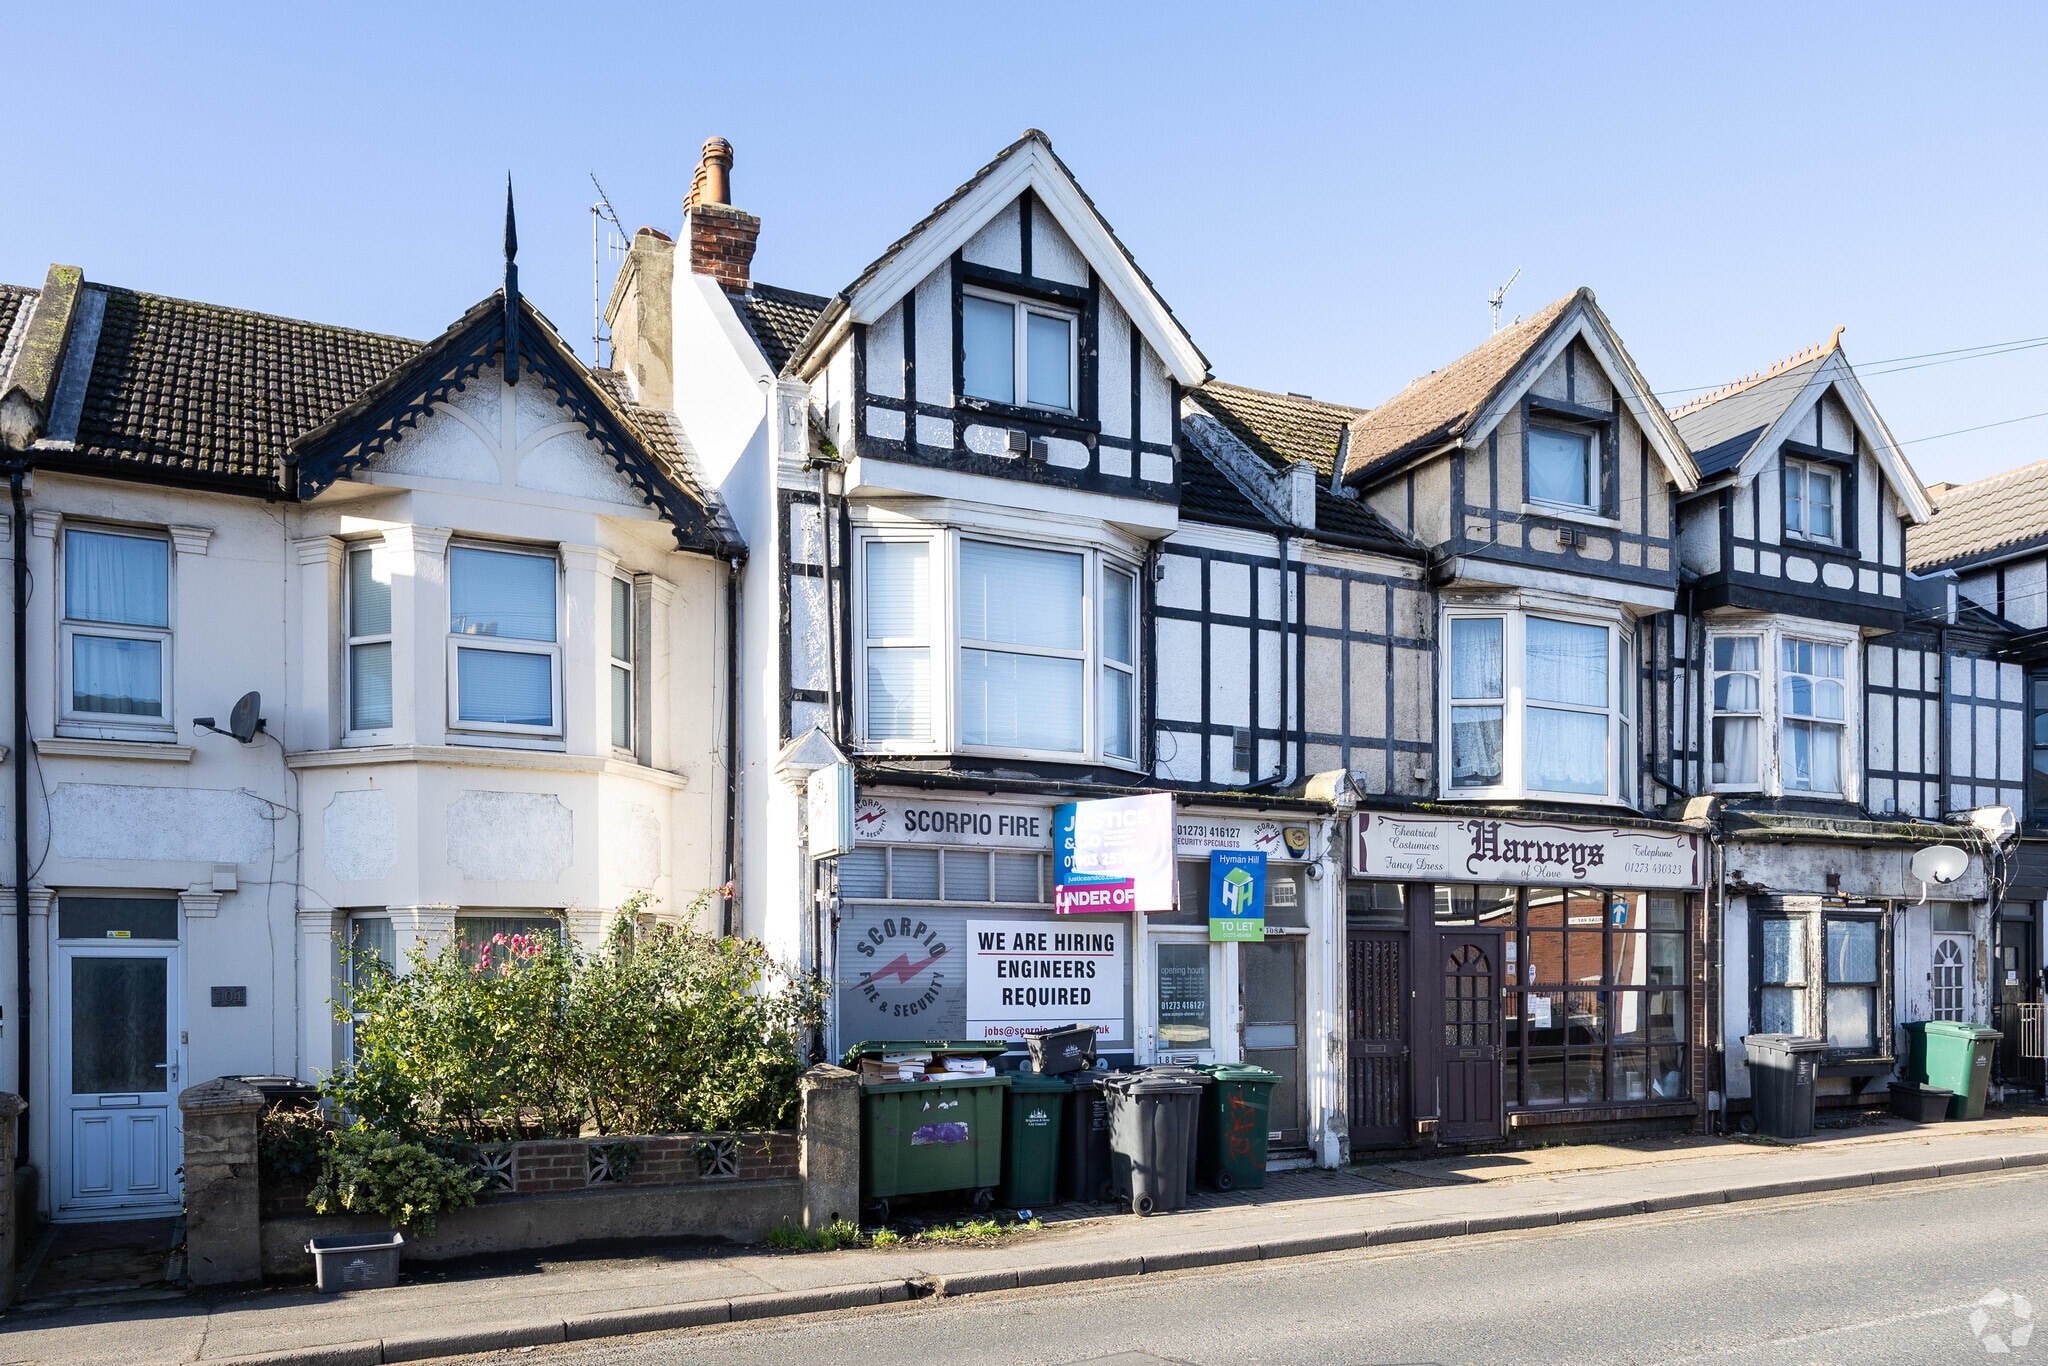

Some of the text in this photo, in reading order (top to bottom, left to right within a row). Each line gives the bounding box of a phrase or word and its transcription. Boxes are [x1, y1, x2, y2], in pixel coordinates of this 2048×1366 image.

[904, 809, 992, 836] SCORPIO
[998, 814, 1040, 838] FIRE
[1254, 822, 1280, 836] SCORPIO
[1391, 823, 1438, 838] Theatrical
[1210, 827, 1240, 838] 416127
[1177, 838, 1240, 848] ECURITY SPECIALISTS
[1389, 837, 1440, 851] Costumiers
[1466, 819, 1605, 880] Harveys
[1632, 843, 1674, 860] Telephone
[1220, 855, 1260, 864] Hyman Hill
[1384, 856, 1444, 873] Fancy Dress
[1521, 864, 1562, 880] of Hove
[1624, 862, 1682, 875] 01273 430323
[1056, 890, 1111, 907] UNDER
[1220, 922, 1254, 931] TO LET
[857, 917, 946, 958] SCORPIO
[978, 932, 1114, 952] WE ARE HIRING
[998, 960, 1096, 978] ENGINEERS
[1160, 966, 1205, 976] opening hours
[216, 990, 242, 1002] 104
[879, 1001, 888, 1013] &
[894, 972, 944, 1017] SECURITY
[1002, 988, 1092, 1008] REQUIRED
[1161, 1001, 1205, 1010] 01273 416127
